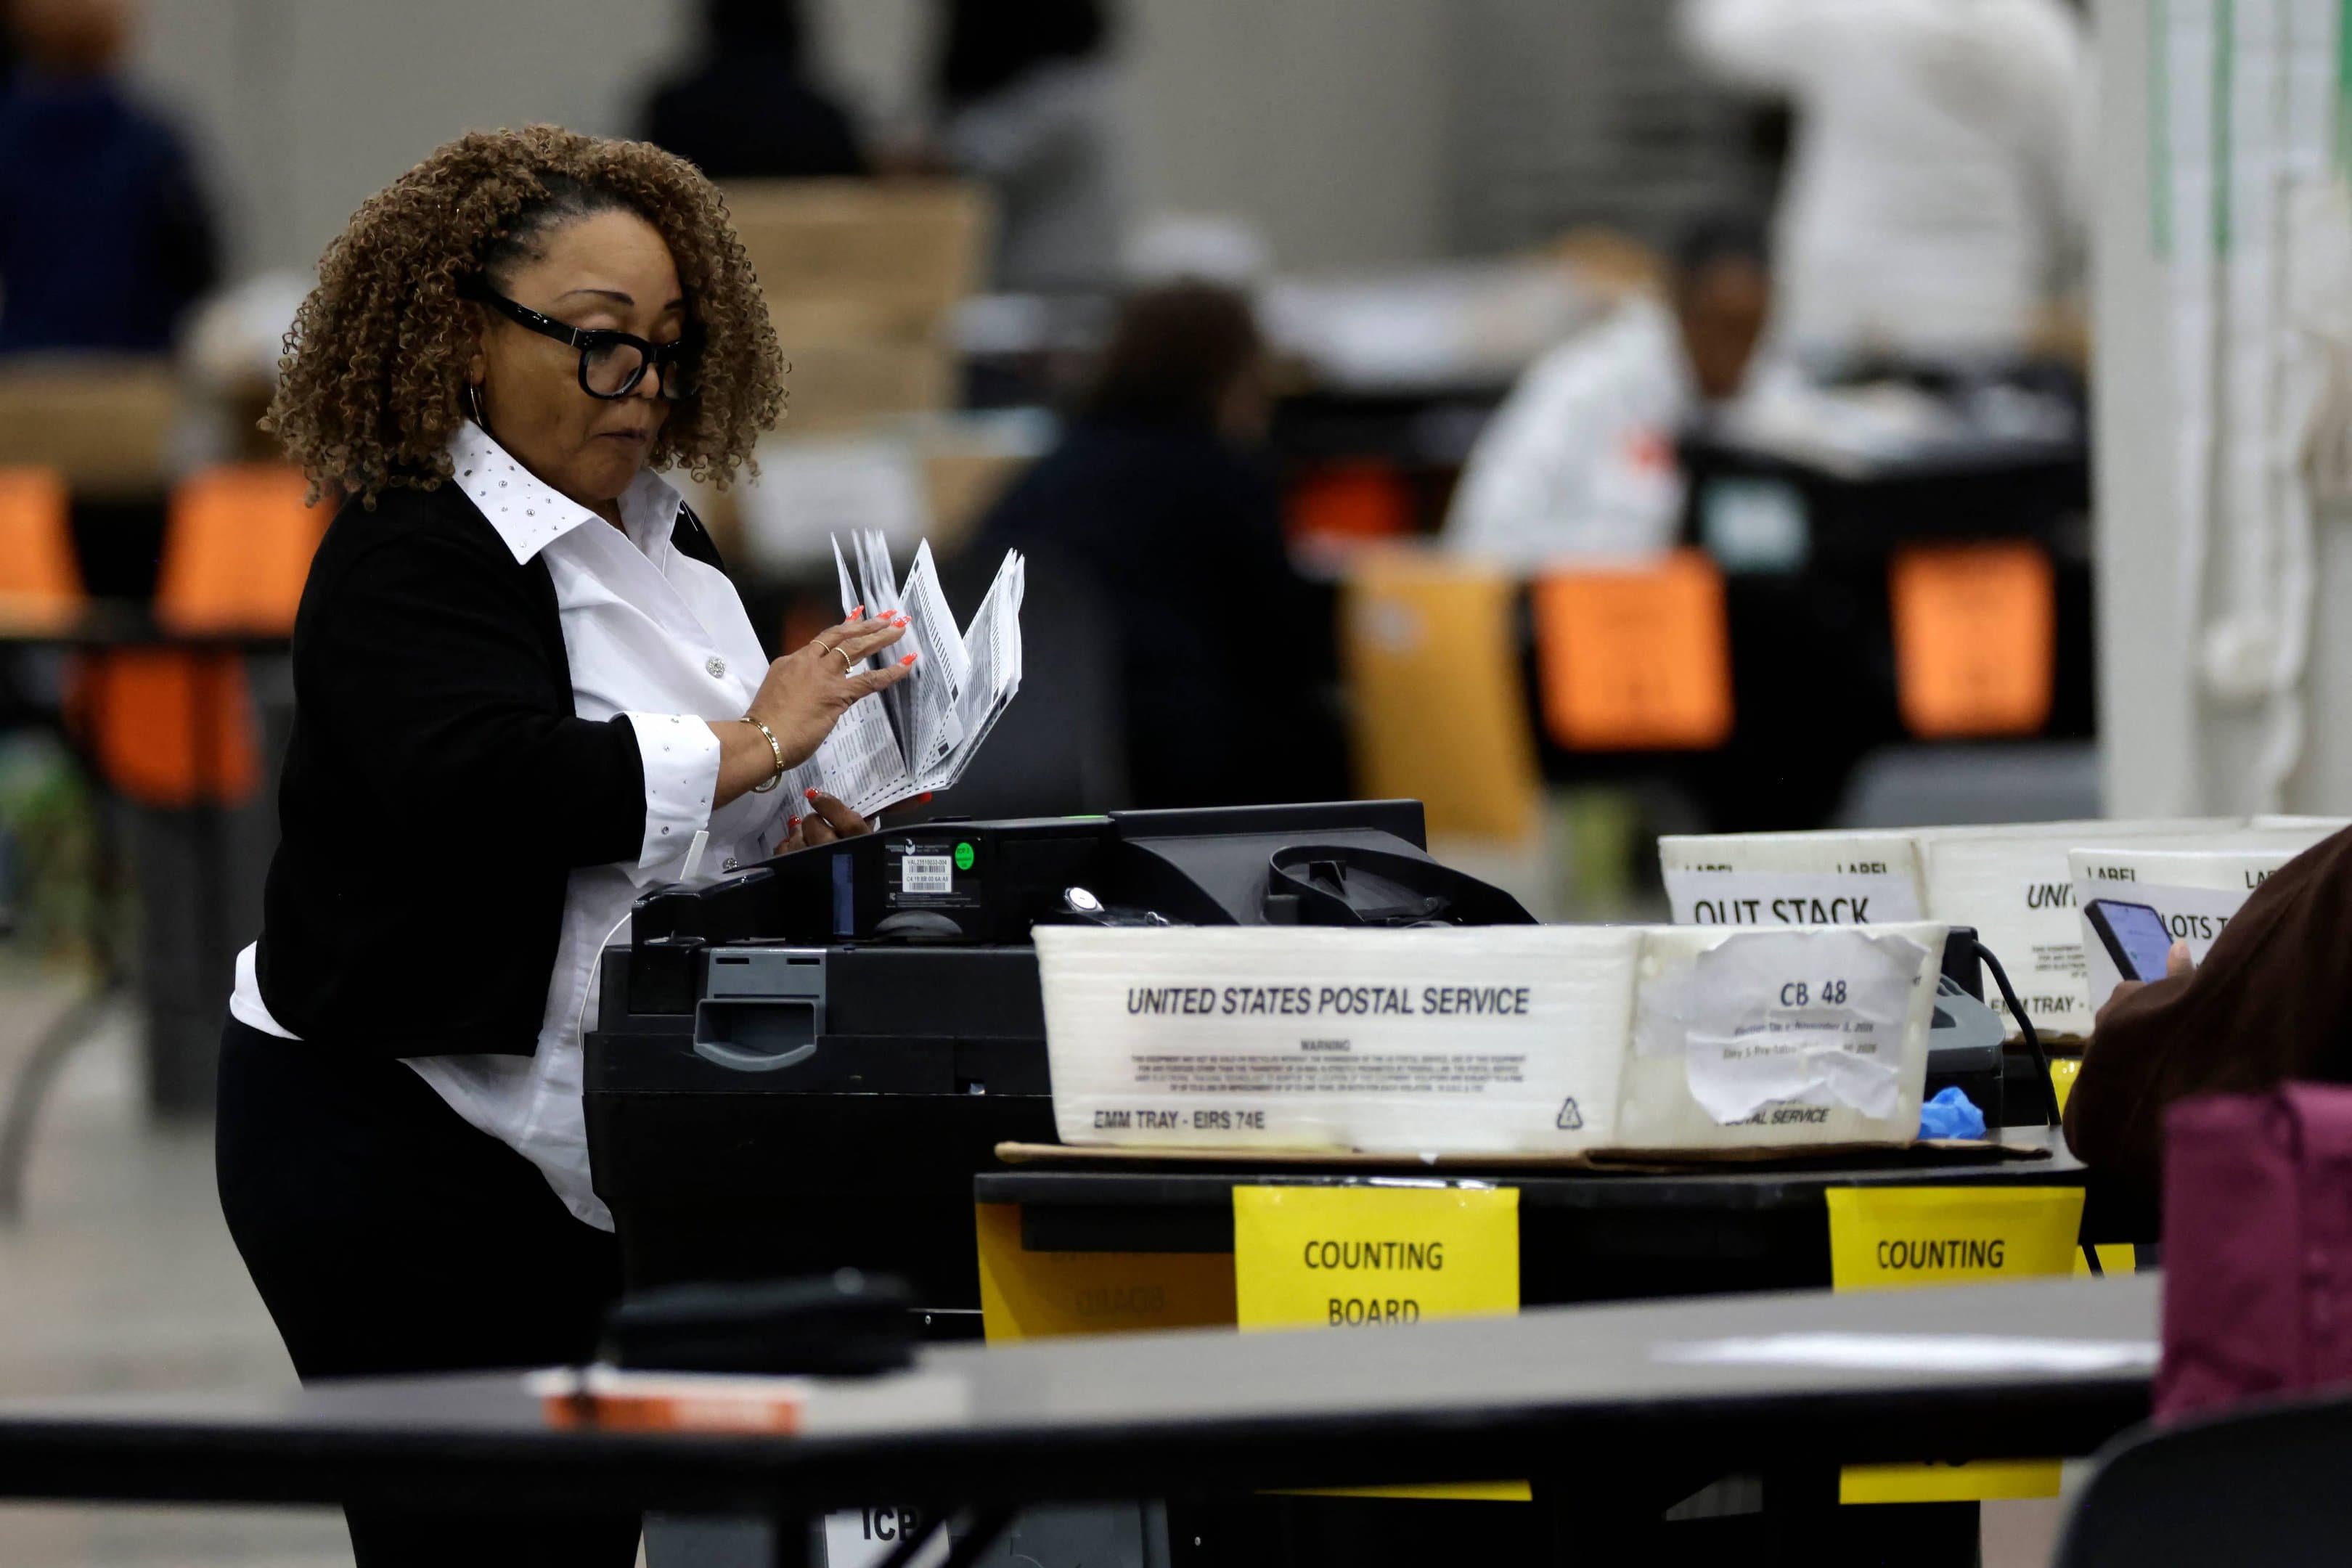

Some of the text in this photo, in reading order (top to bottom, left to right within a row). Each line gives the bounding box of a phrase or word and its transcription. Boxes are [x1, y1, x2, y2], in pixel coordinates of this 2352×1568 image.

[1694, 897, 1870, 925] OUT STACK
[1127, 987, 1530, 1015] UNITED STATES POSTAL SERVICE
[1781, 979, 1847, 1008] CB 48
[2033, 995, 2075, 1014] TRAY
[1300, 1039, 1350, 1052] WARNING
[1094, 1110, 1131, 1130] EMM
[1136, 1110, 1179, 1130] TRAY
[1193, 1110, 1232, 1130] EIRS
[1236, 1110, 1266, 1130] 74E
[1771, 1108, 1830, 1125] SERVICE
[1304, 1240, 1444, 1271] COUNTING
[1878, 1239, 2006, 1270] COUNTING
[1329, 1298, 1421, 1328] BOARD
